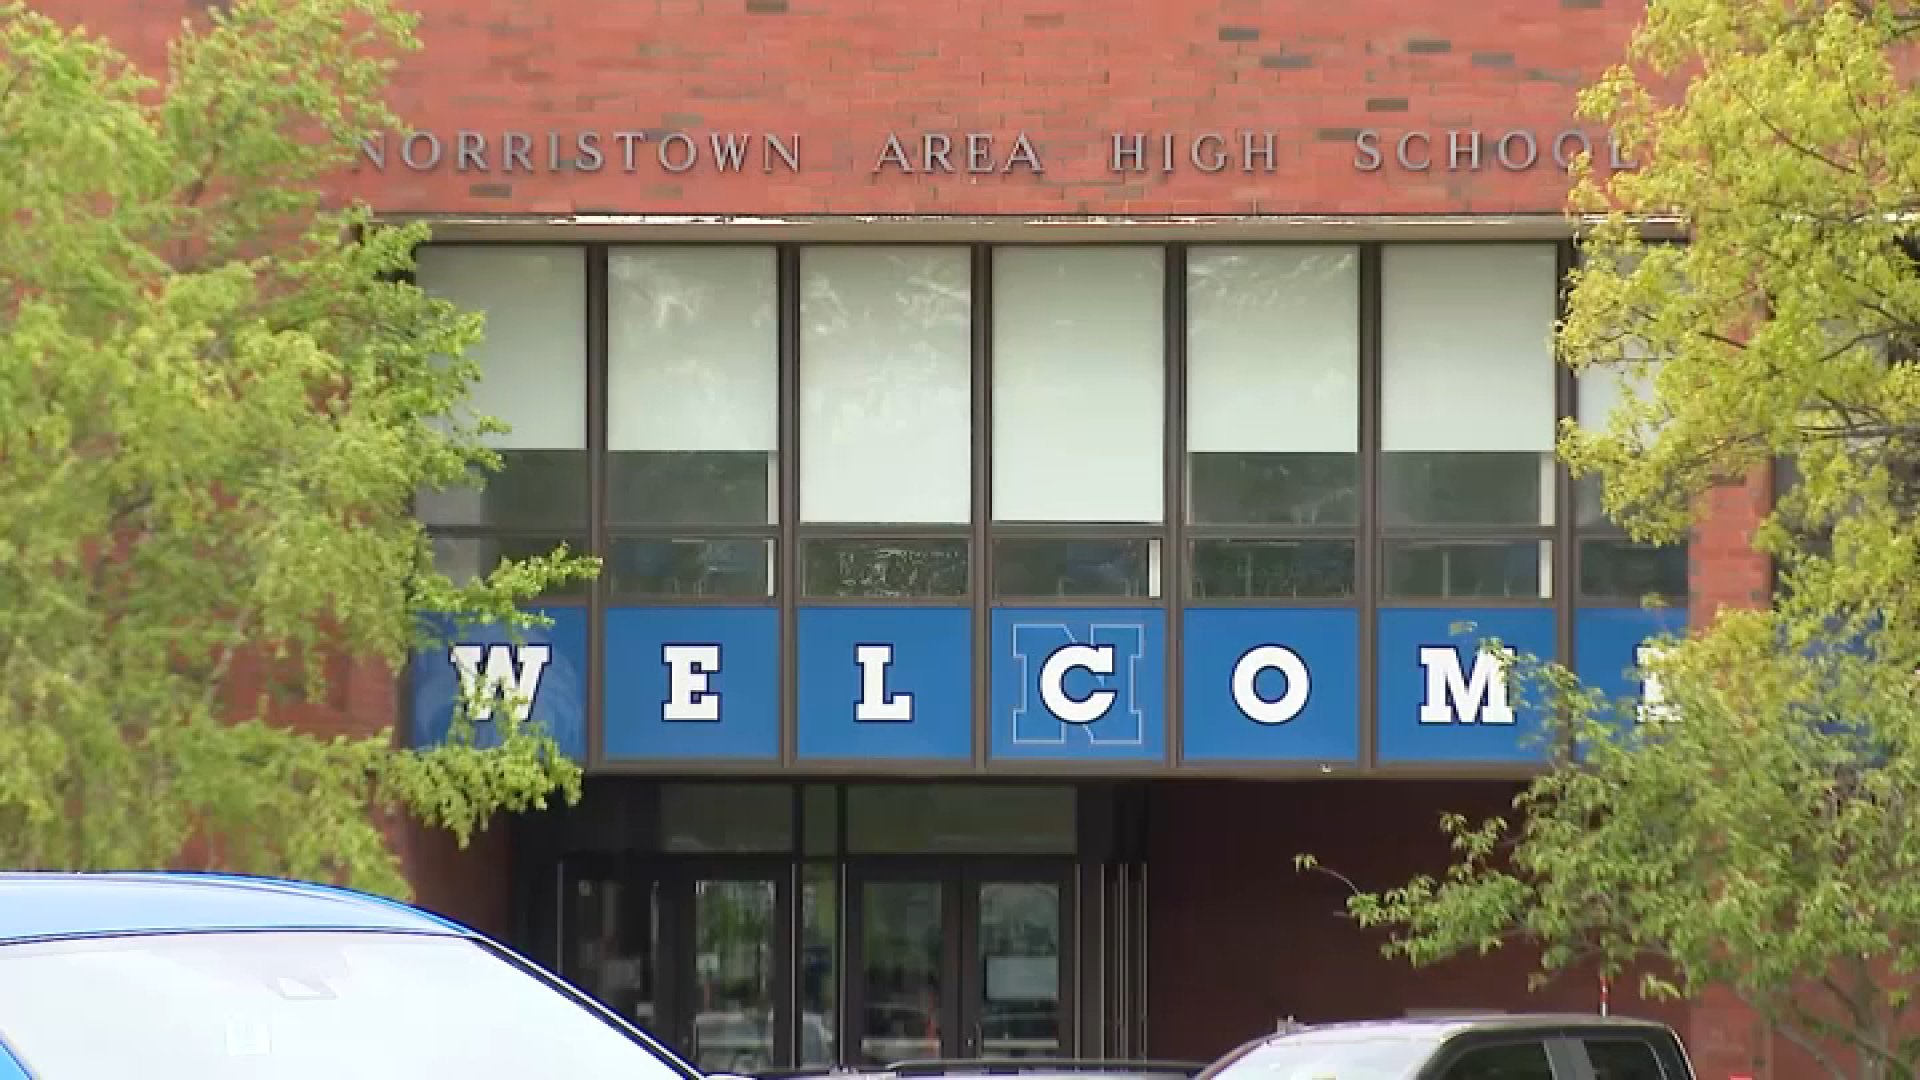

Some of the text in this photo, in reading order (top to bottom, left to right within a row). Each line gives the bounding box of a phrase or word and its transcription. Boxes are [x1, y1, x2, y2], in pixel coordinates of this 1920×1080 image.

[354, 128, 1640, 174] NORRISTOWN AREA HIGH SCHOOL
